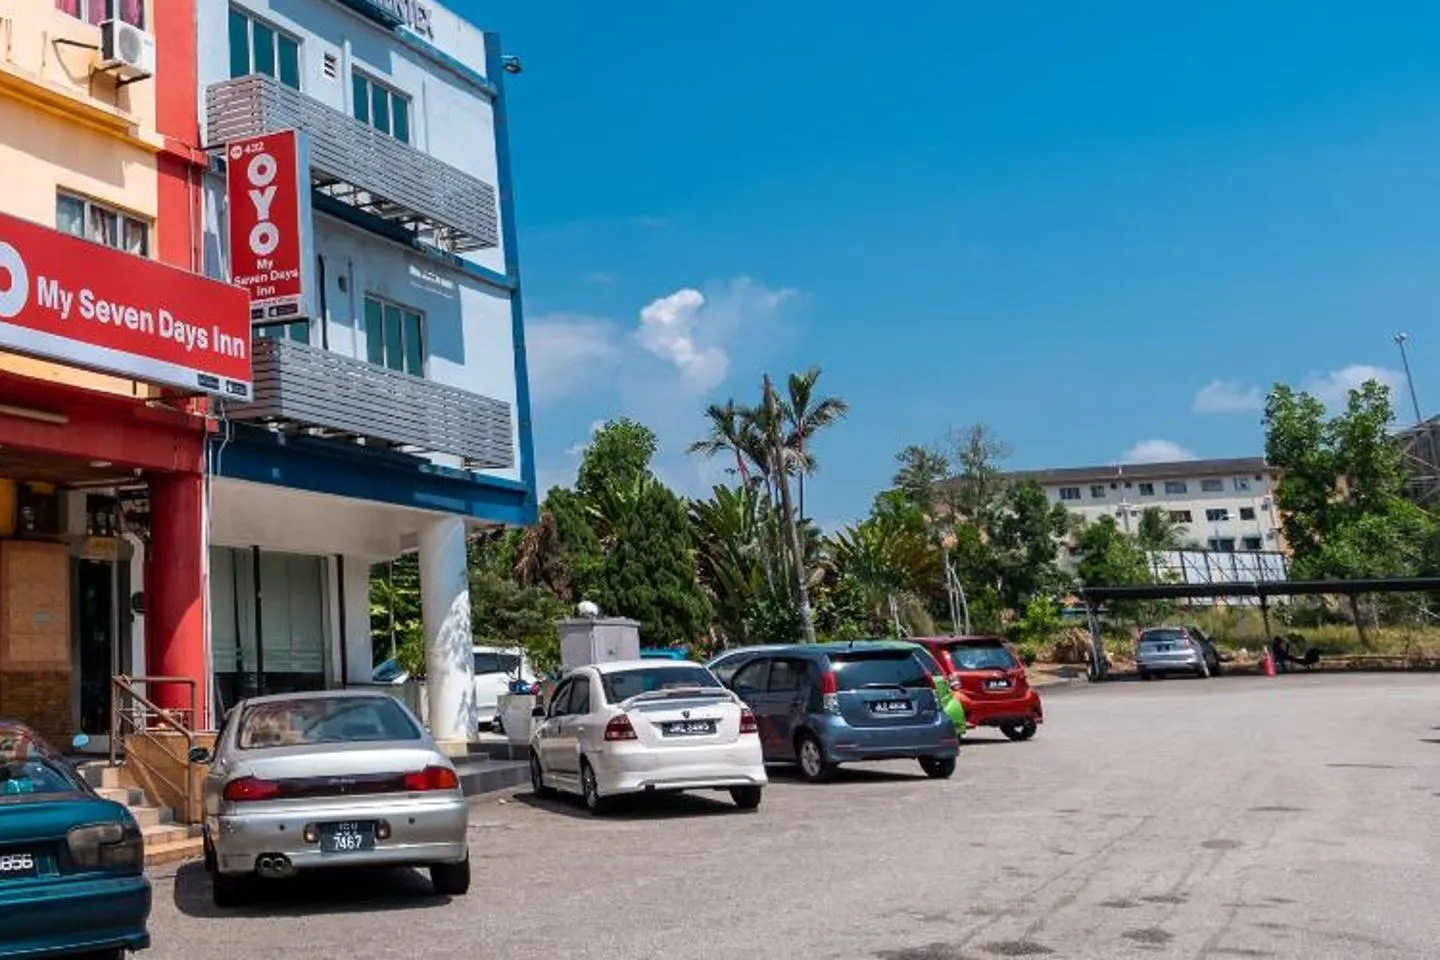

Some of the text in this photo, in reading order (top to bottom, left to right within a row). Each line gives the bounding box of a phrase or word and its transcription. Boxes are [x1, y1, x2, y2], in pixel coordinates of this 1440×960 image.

[247, 153, 279, 256] OYO
[256, 259, 273, 271] My
[256, 286, 276, 297] Inn
[36, 276, 246, 359] My Seven Days Inn
